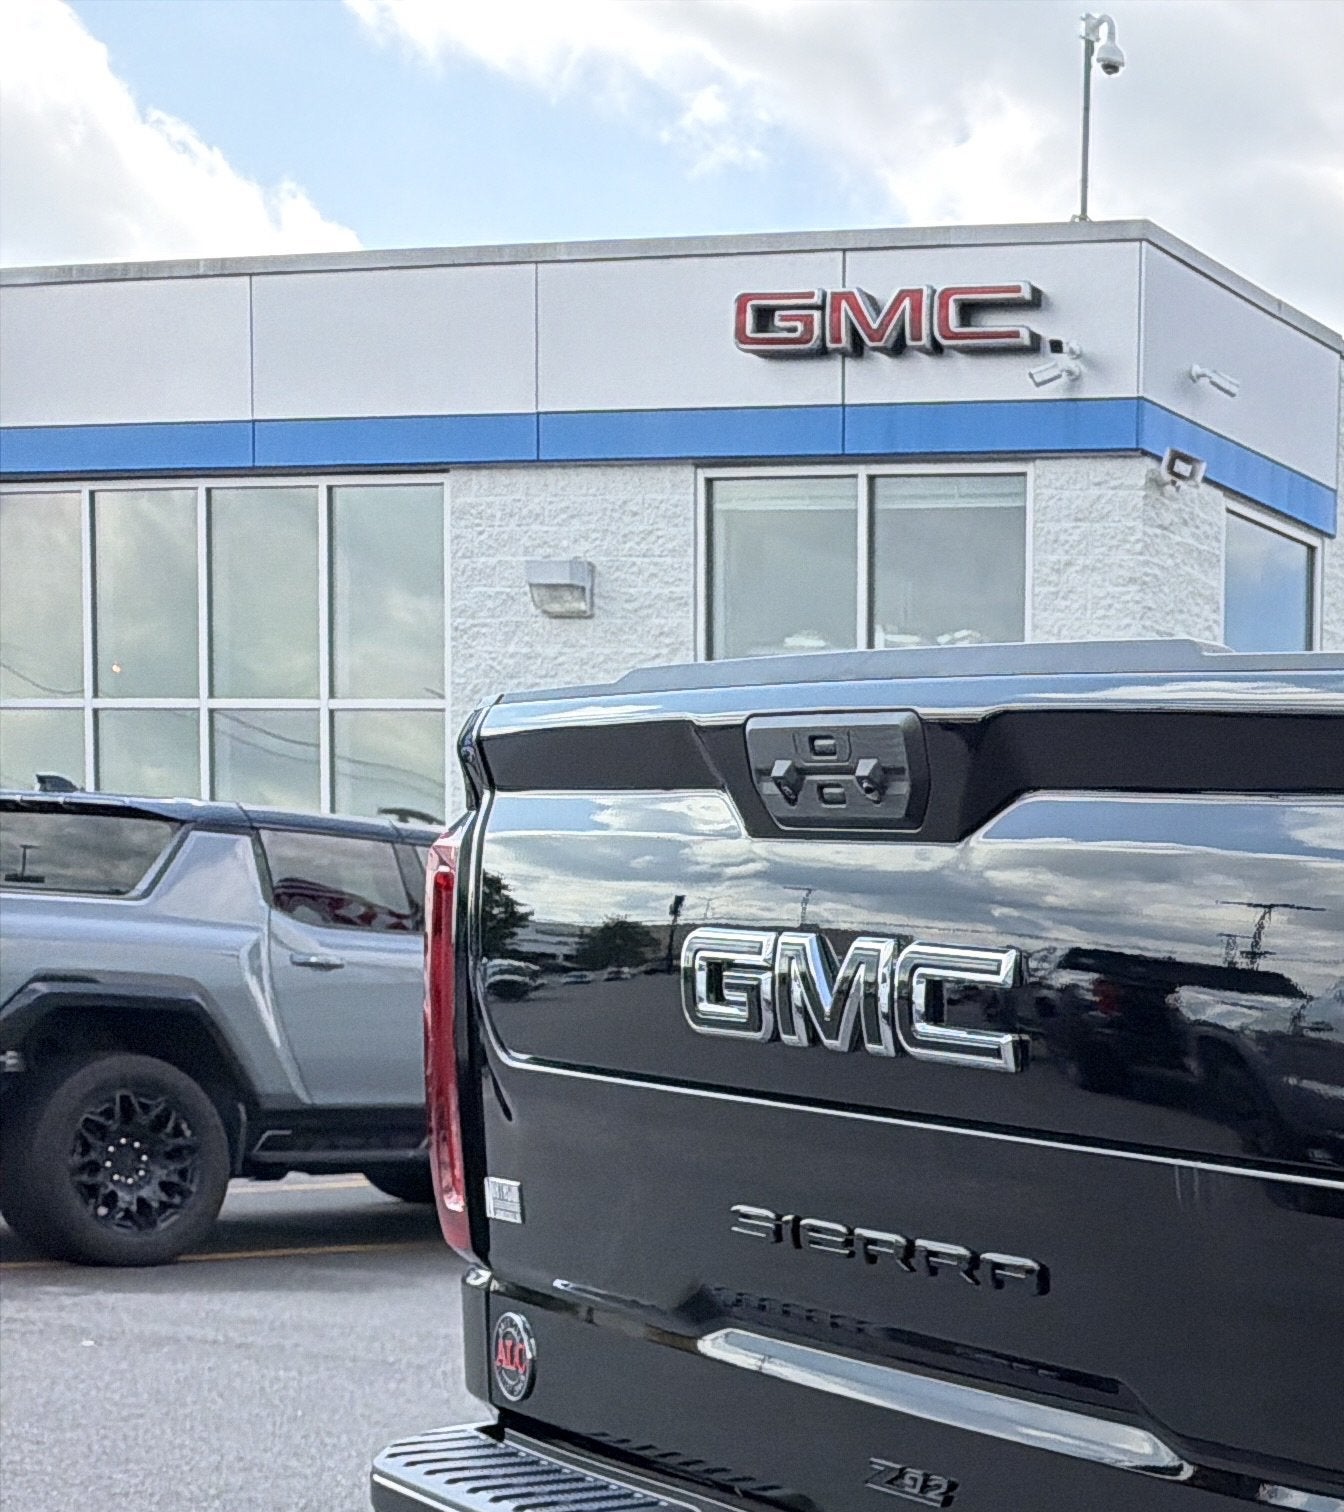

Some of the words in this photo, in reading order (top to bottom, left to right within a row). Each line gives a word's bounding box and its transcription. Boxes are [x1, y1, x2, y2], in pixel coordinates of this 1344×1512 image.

[734, 280, 1042, 358] GMC
[680, 927, 1030, 1073] GMC
[730, 1204, 1050, 1297] SIERRA
